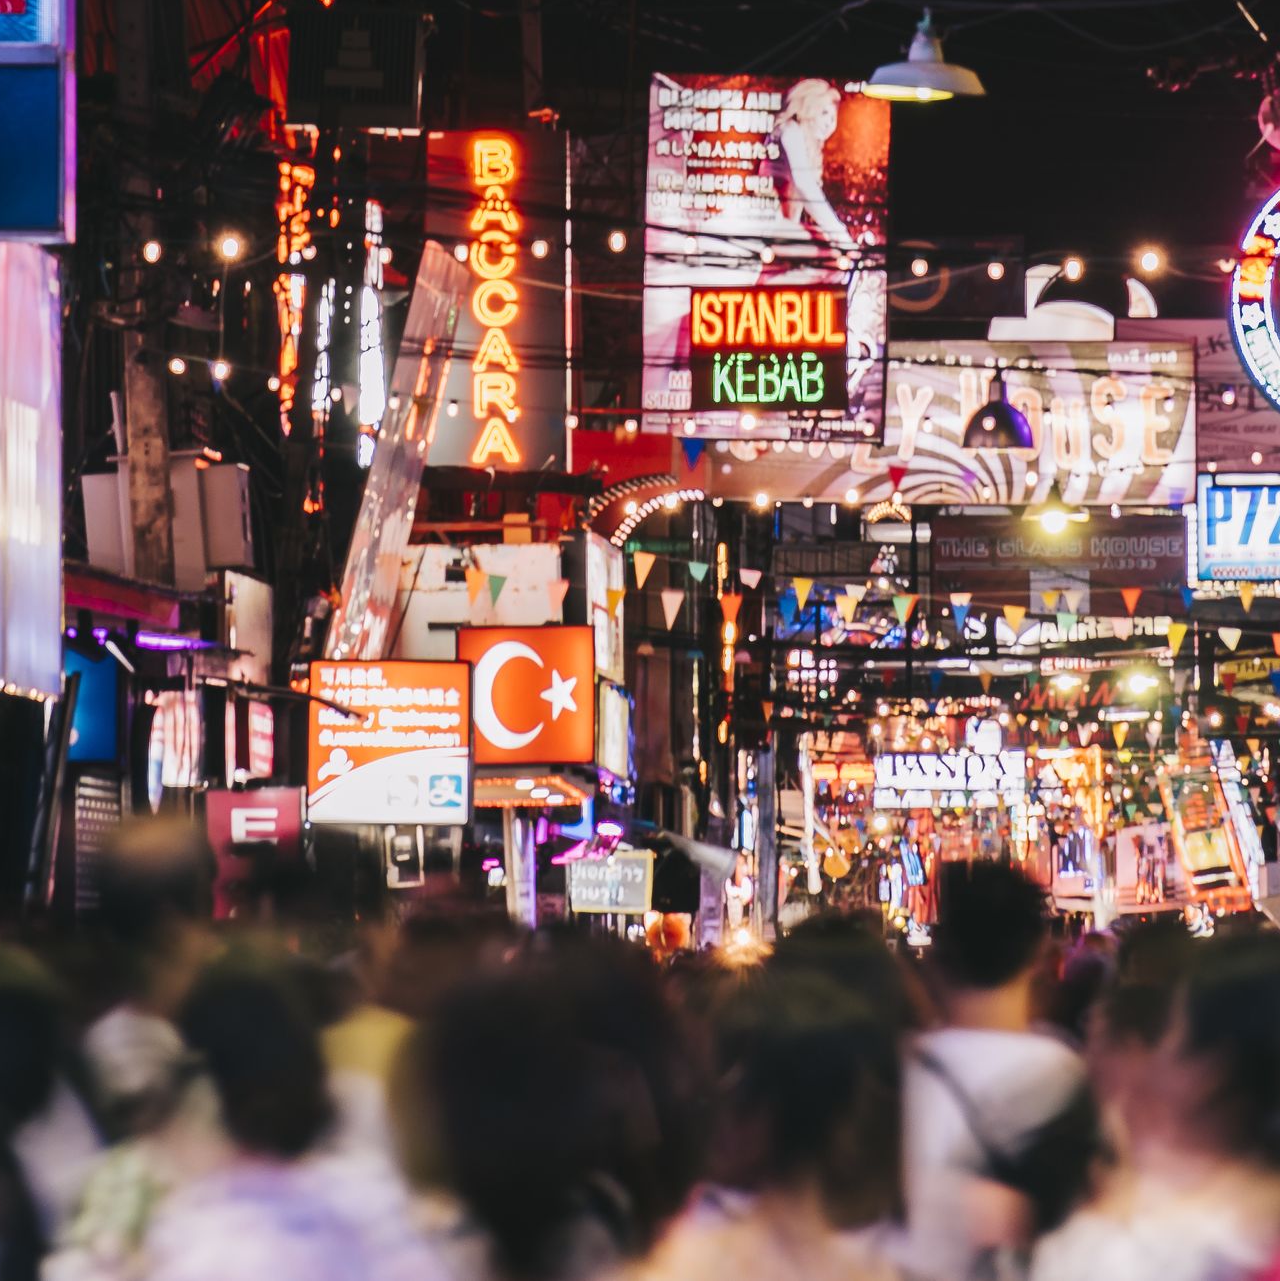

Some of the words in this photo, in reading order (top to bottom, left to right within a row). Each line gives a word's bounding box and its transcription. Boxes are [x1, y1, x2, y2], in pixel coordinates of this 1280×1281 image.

[469, 138, 521, 465] BACCARA
[691, 291, 847, 345] ISTANBUL
[712, 351, 825, 404] KEBAB
[1090, 535, 1184, 560] HOUSE
